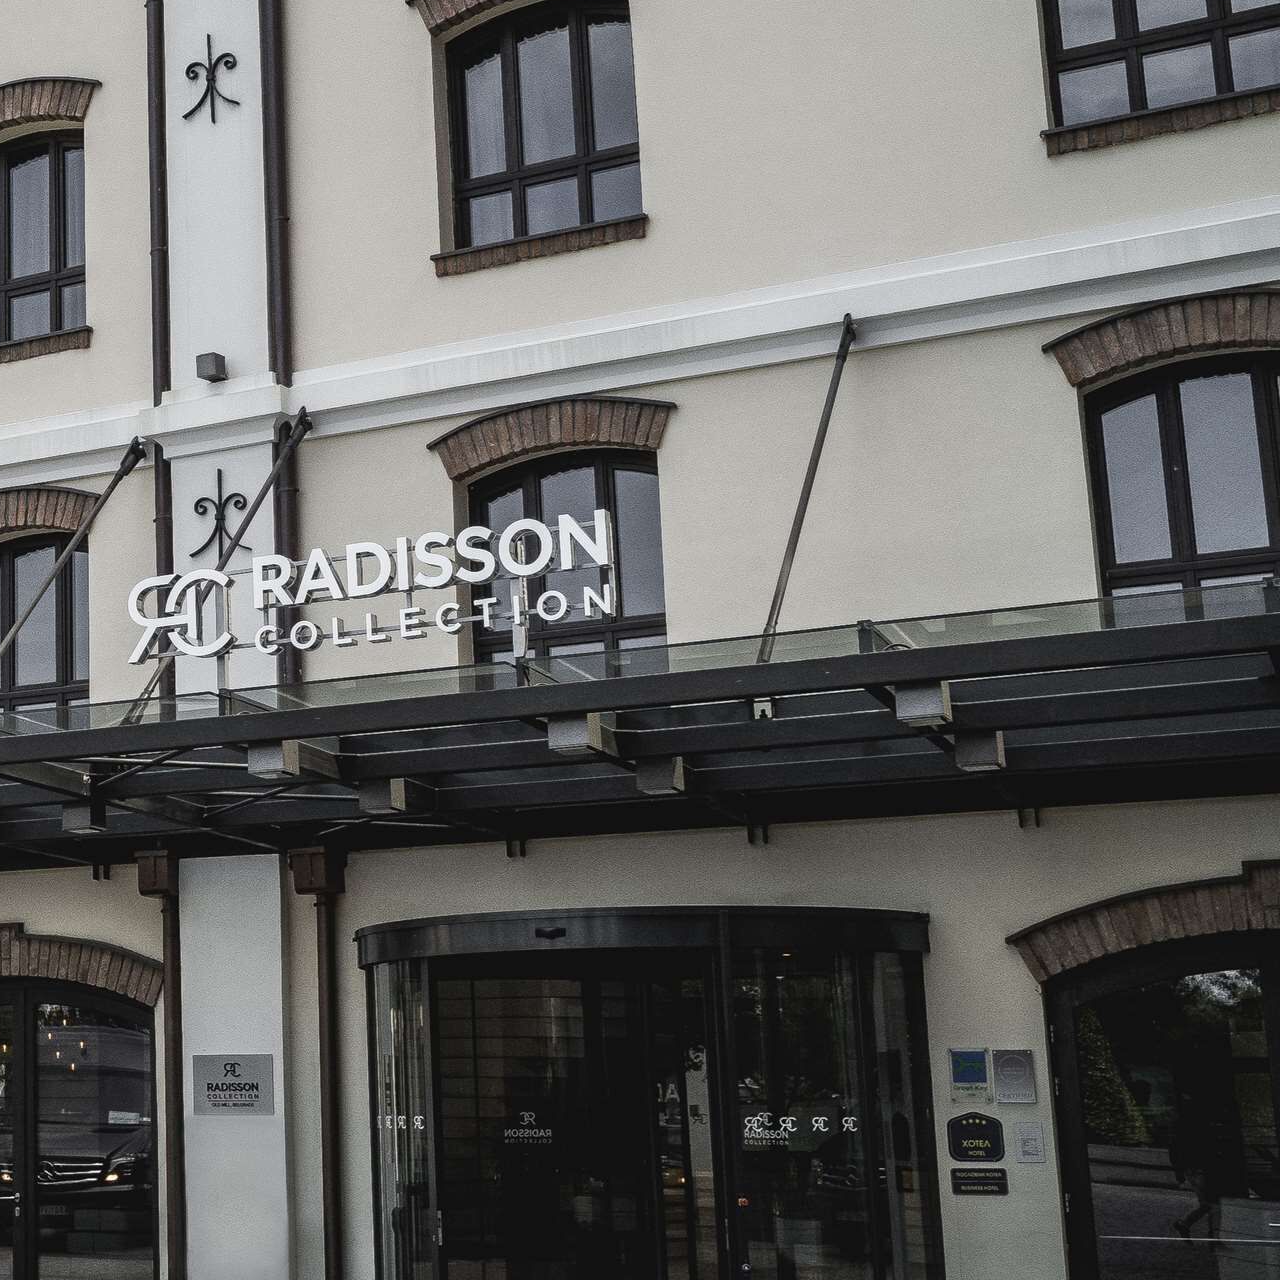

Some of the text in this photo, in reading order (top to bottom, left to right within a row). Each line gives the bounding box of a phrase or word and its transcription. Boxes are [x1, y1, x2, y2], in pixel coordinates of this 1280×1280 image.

[252, 509, 613, 610] RADISSON
[254, 583, 615, 655] COLLECTION
[206, 1082, 259, 1092] RADISSON
[743, 1130, 789, 1139] RADISSON
